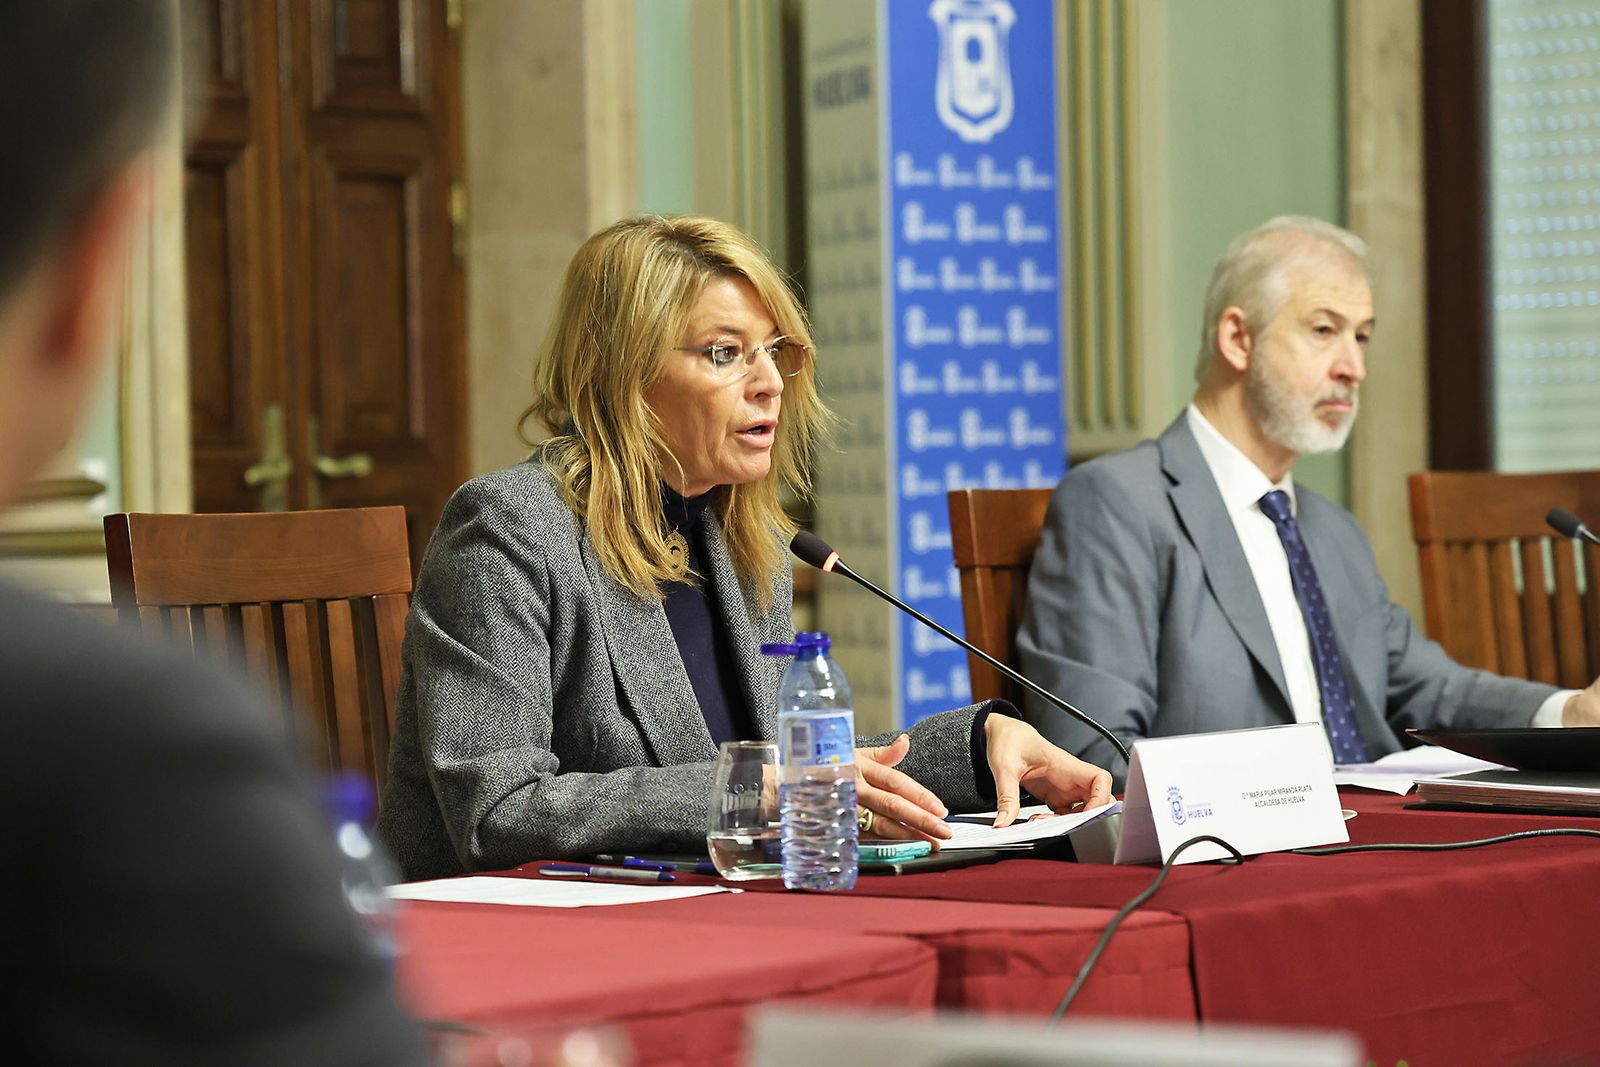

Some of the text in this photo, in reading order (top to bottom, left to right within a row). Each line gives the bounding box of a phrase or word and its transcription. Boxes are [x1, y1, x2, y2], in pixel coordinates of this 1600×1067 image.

[1264, 788, 1277, 796] PILAR
[1277, 786, 1298, 795] MIRANDA
[1298, 784, 1313, 793] PLATA
[1254, 796, 1305, 808] ALCALDESA DE HUELVA
[1187, 808, 1214, 819] HUELVA
